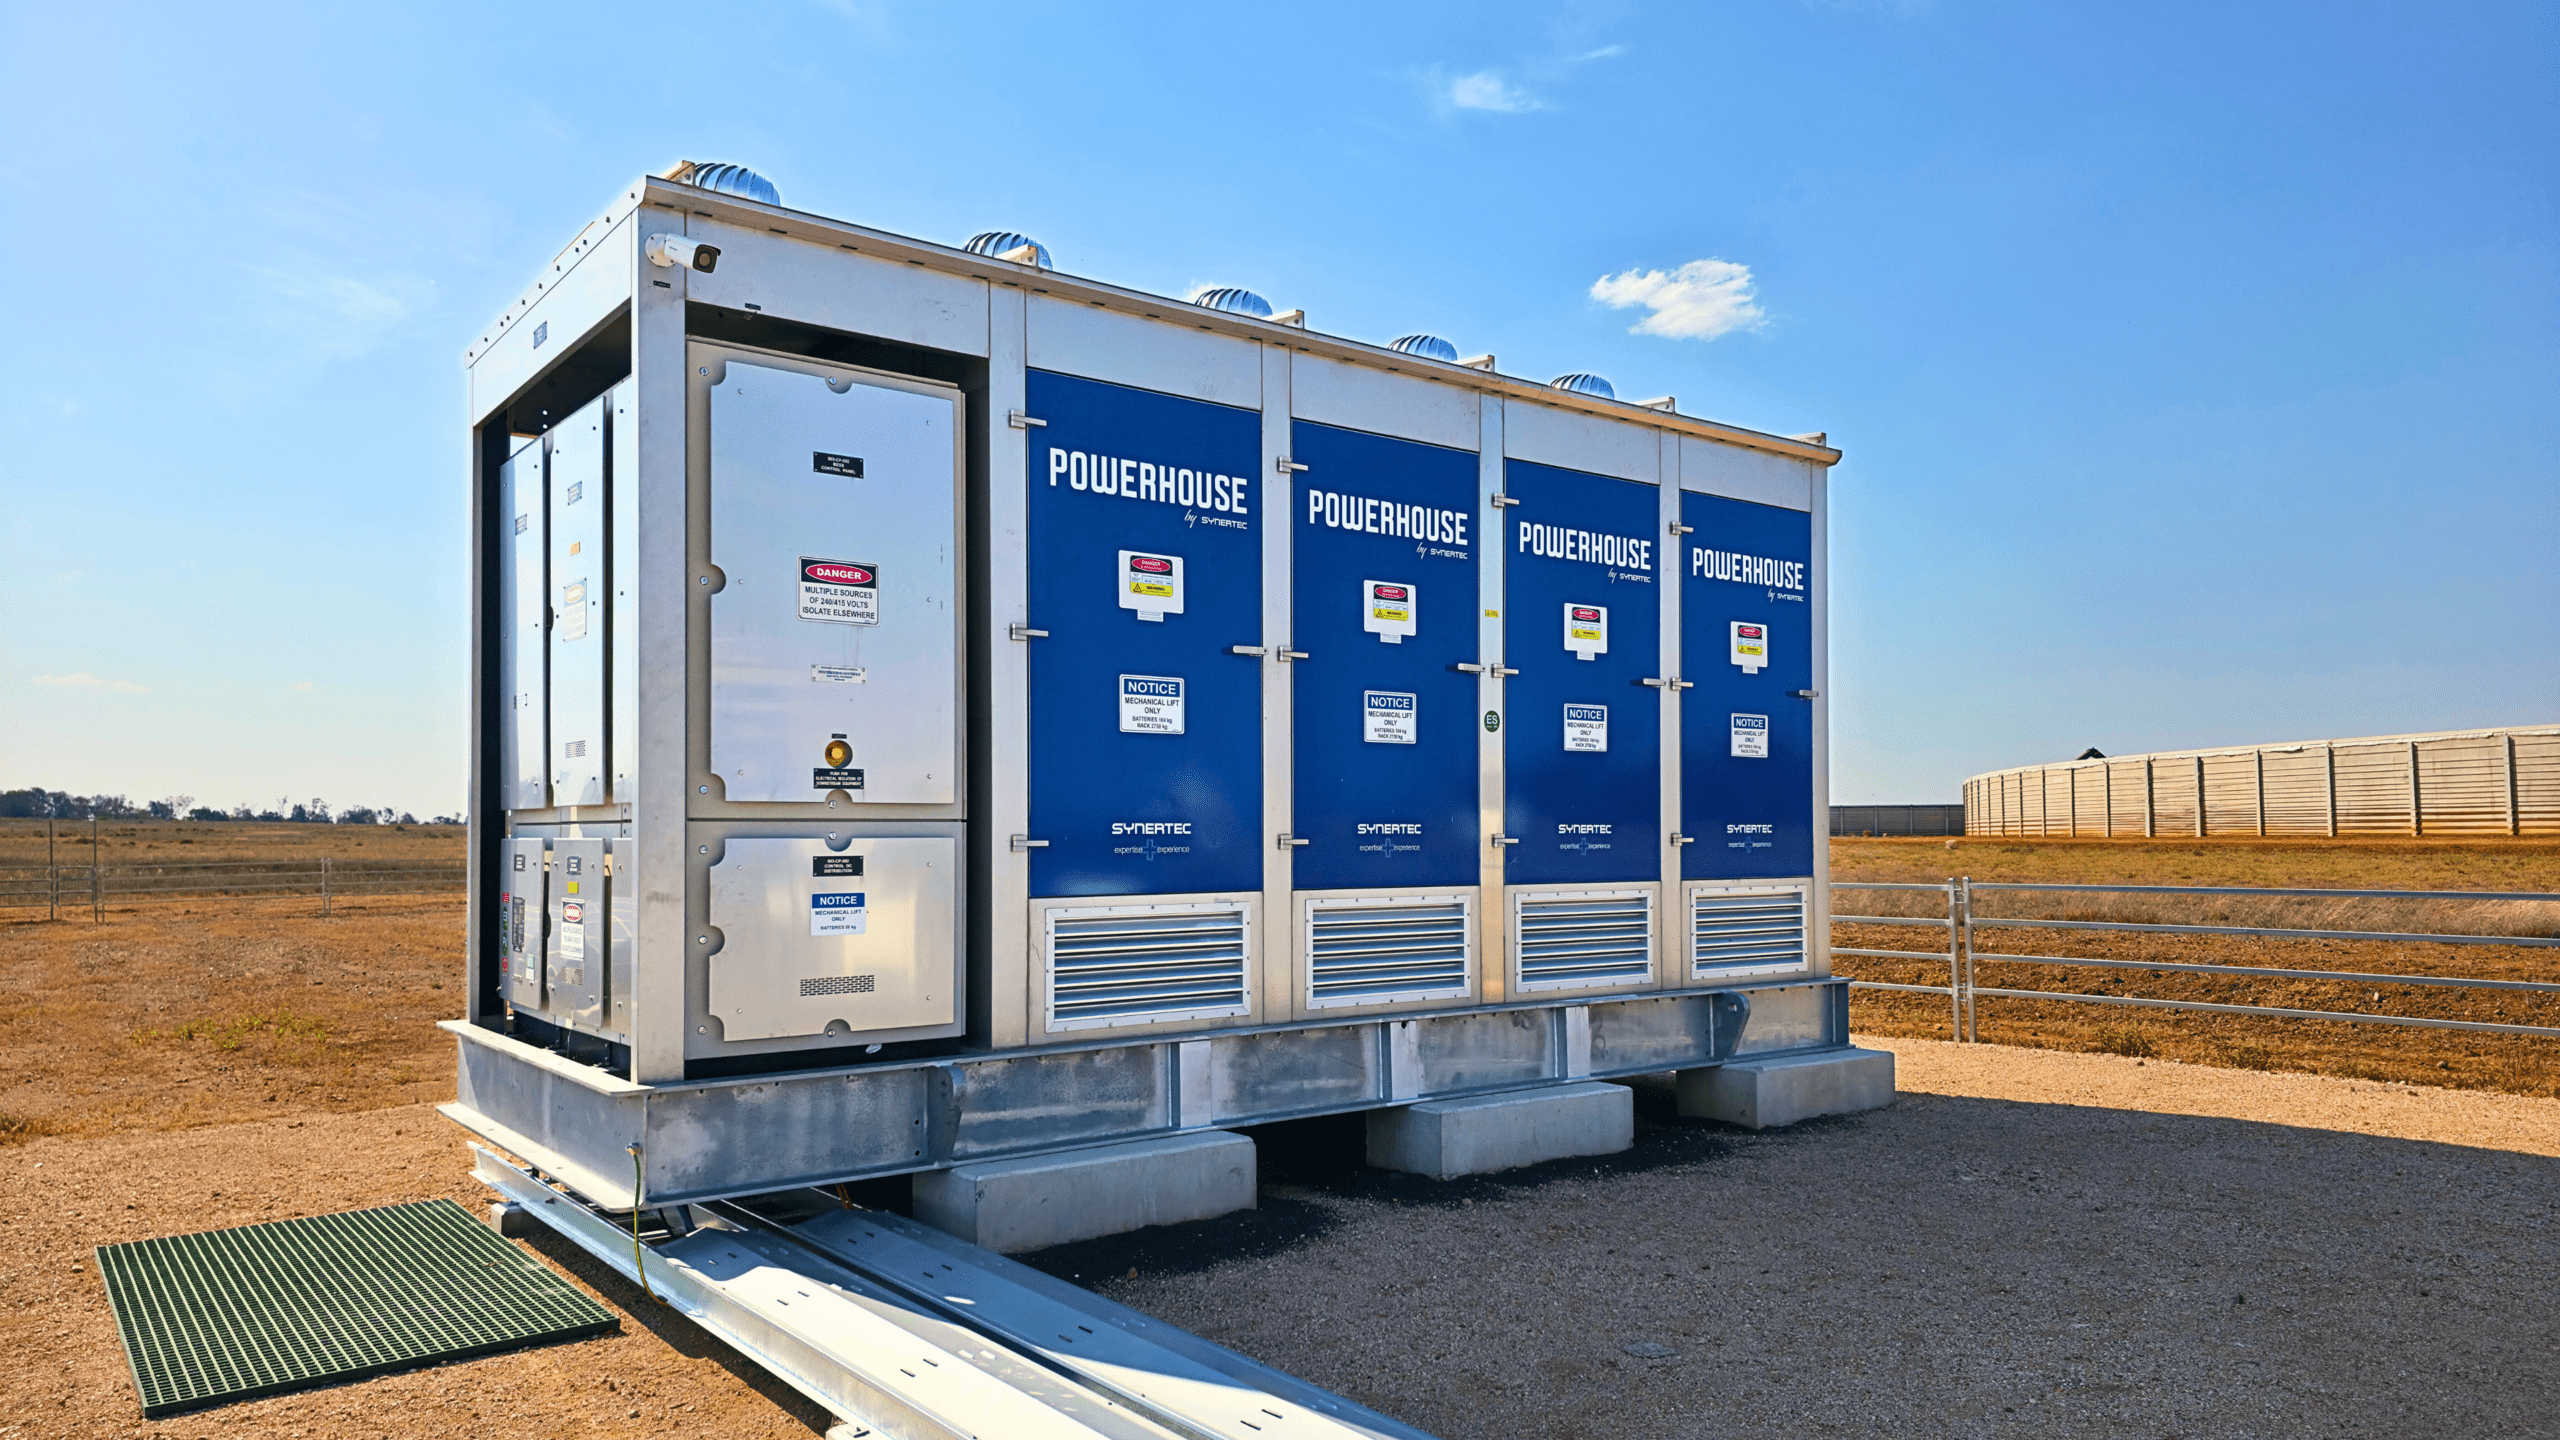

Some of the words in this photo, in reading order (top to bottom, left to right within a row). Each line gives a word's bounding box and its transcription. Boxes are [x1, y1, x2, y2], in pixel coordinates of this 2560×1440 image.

[1050, 447, 1248, 515] POWERHOUSE
[1184, 509, 1197, 529] by
[1201, 516, 1248, 530] SYNERTEC
[1309, 489, 1468, 546] POWERHOUSE
[1416, 541, 1427, 560] by
[1430, 548, 1468, 560] SYNERTEC
[1519, 521, 1651, 571] POWERHOUSE
[817, 568, 861, 580] DANGER
[1692, 547, 1804, 590] POWERHOUSE
[1607, 567, 1617, 584] by
[1619, 573, 1651, 583] SYNERTEC
[805, 586, 838, 596] MULTIPLE
[840, 589, 873, 599] SOURCES
[1767, 588, 1775, 603] by
[1777, 592, 1804, 602] SYNERTEC
[809, 596, 819, 604] OF
[820, 597, 845, 606] 240/415
[847, 600, 868, 609] VOLTS
[802, 606, 831, 615] ISOLATE
[833, 609, 875, 619] ELSEWHERE
[1128, 681, 1176, 695] NOTICE
[1125, 697, 1165, 706] MECHANICAL
[1371, 696, 1410, 708] NOTICE
[1144, 706, 1161, 714] ONLY
[1569, 709, 1602, 720] NOTICE
[1487, 715, 1497, 724] ES
[1735, 718, 1763, 728] NOTICE
[1111, 822, 1191, 834] SYNERTEC
[1357, 823, 1421, 834] SYNERTEC
[1558, 824, 1612, 834] SYNERTEC
[1727, 824, 1772, 833] SYNERTEC
[1114, 846, 1143, 855] expertise
[1157, 845, 1190, 854] experience
[820, 895, 857, 905] NOTICE
